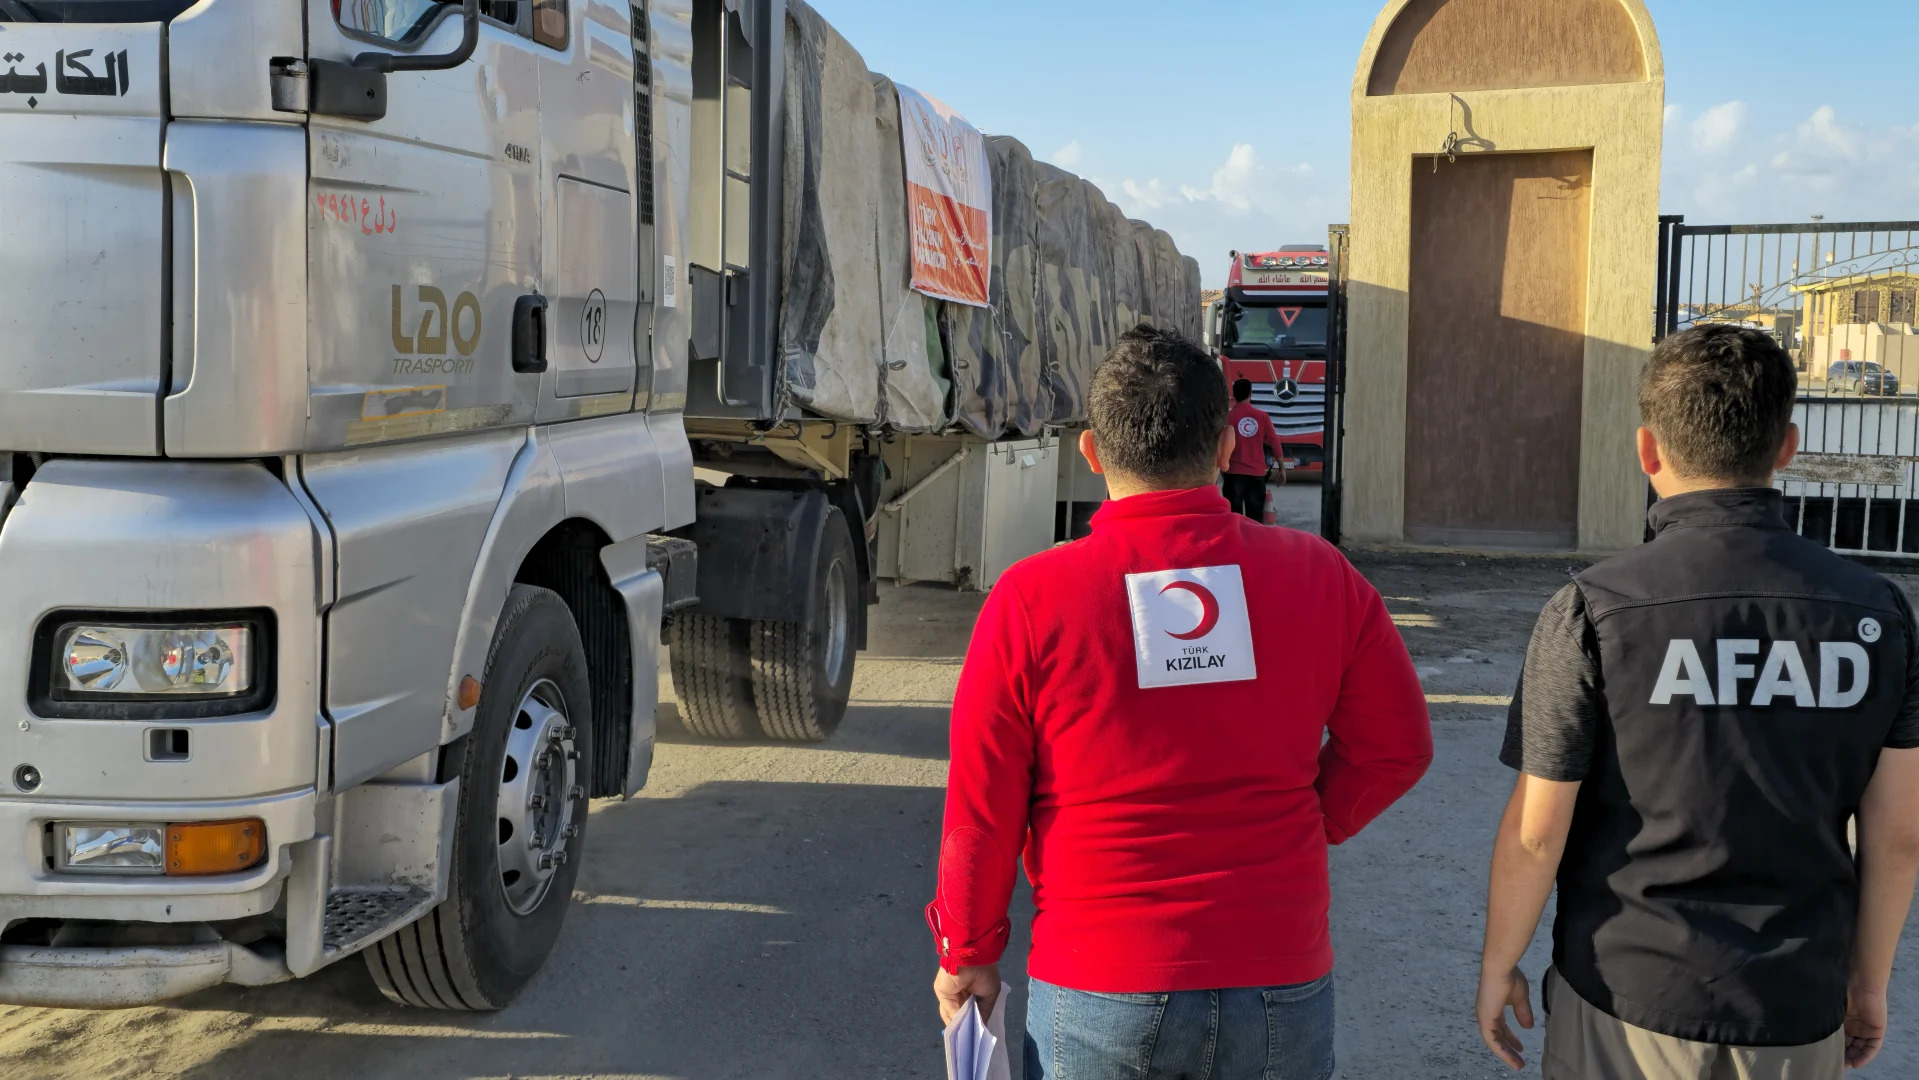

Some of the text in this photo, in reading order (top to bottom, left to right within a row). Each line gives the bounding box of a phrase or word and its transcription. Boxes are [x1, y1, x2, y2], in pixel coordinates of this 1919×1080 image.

[0, 48, 130, 109] الكابت
[1258, 274, 1270, 283] الله
[1299, 274, 1312, 283] الله
[585, 306, 602, 345] 18
[393, 357, 475, 374] TRASPORTI
[1182, 646, 1209, 655] TÜRK
[1165, 654, 1226, 672] KIZILAY
[1648, 638, 1870, 708] AFAD
